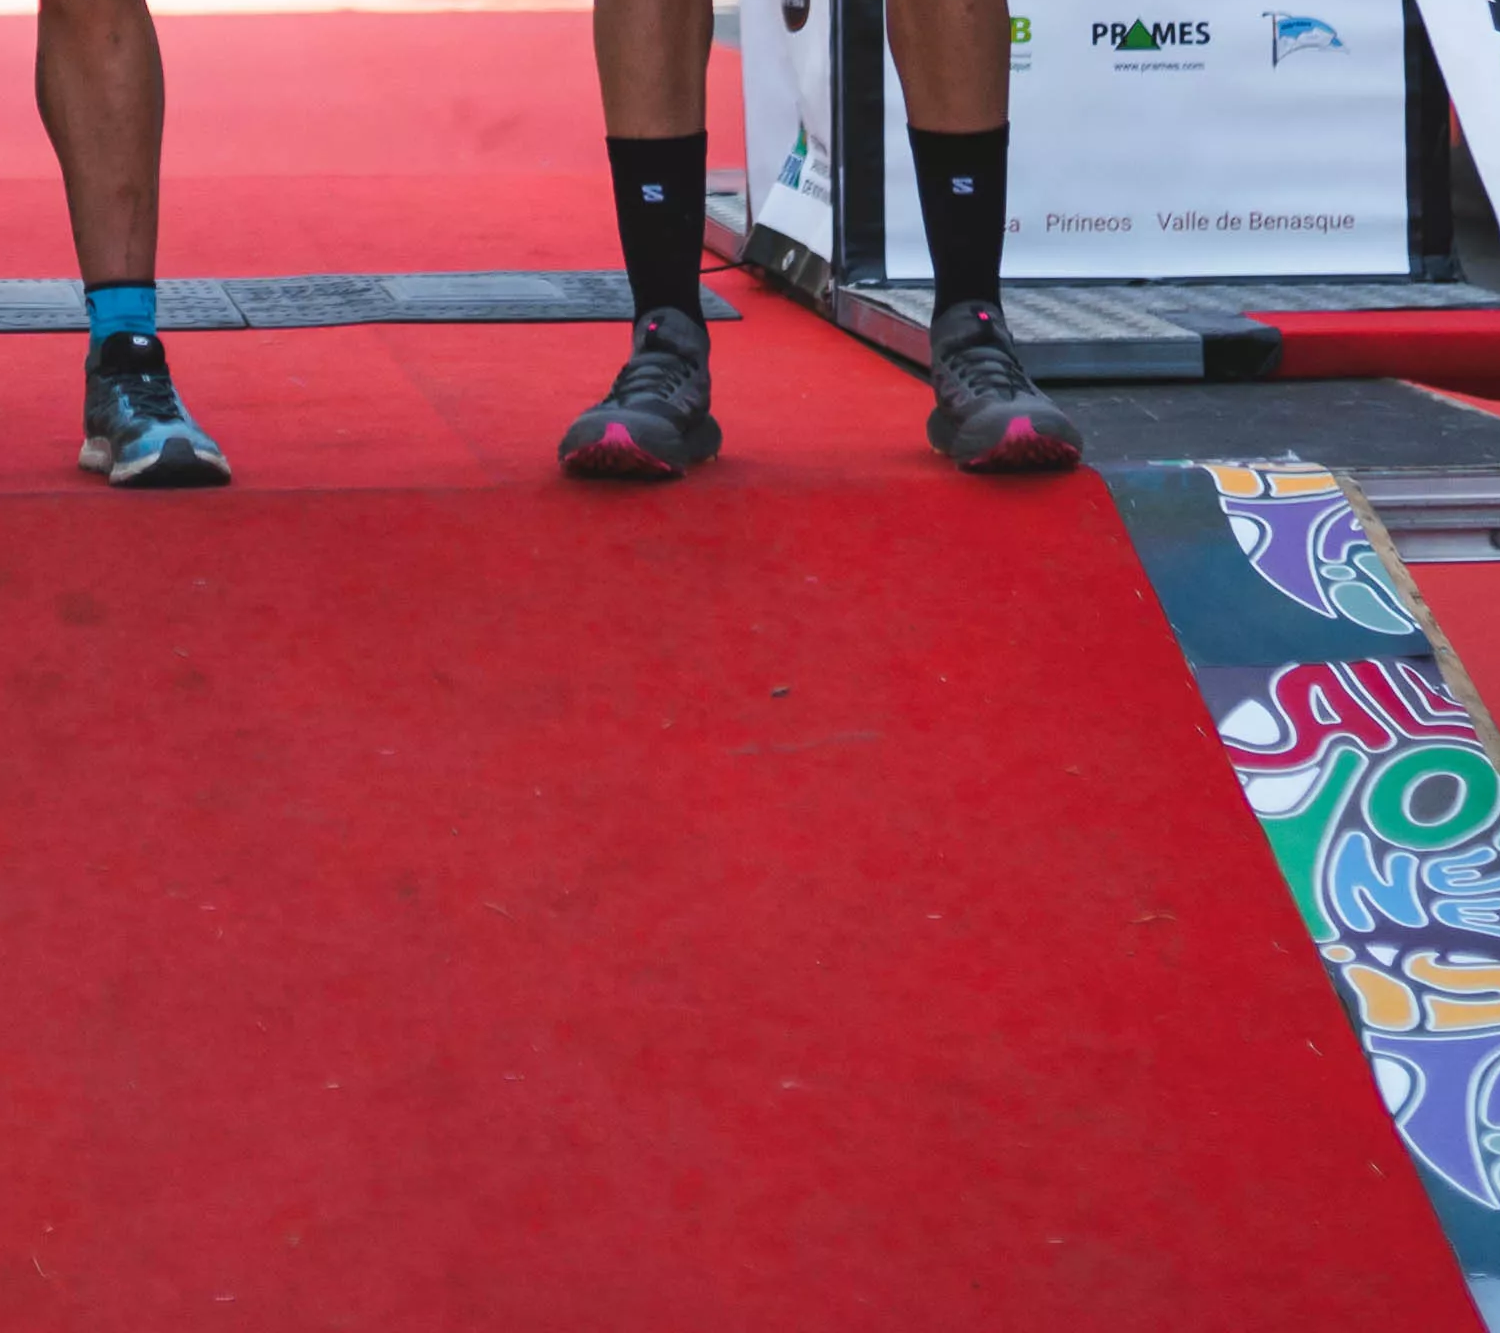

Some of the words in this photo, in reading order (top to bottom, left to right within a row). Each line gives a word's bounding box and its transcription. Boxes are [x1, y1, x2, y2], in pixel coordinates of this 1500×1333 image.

[1092, 19, 1211, 50] PRAMES
[1045, 212, 1132, 232] Pirineos
[1156, 212, 1209, 231] Valle
[1215, 211, 1242, 231] de
[1248, 211, 1355, 236] Benasque
